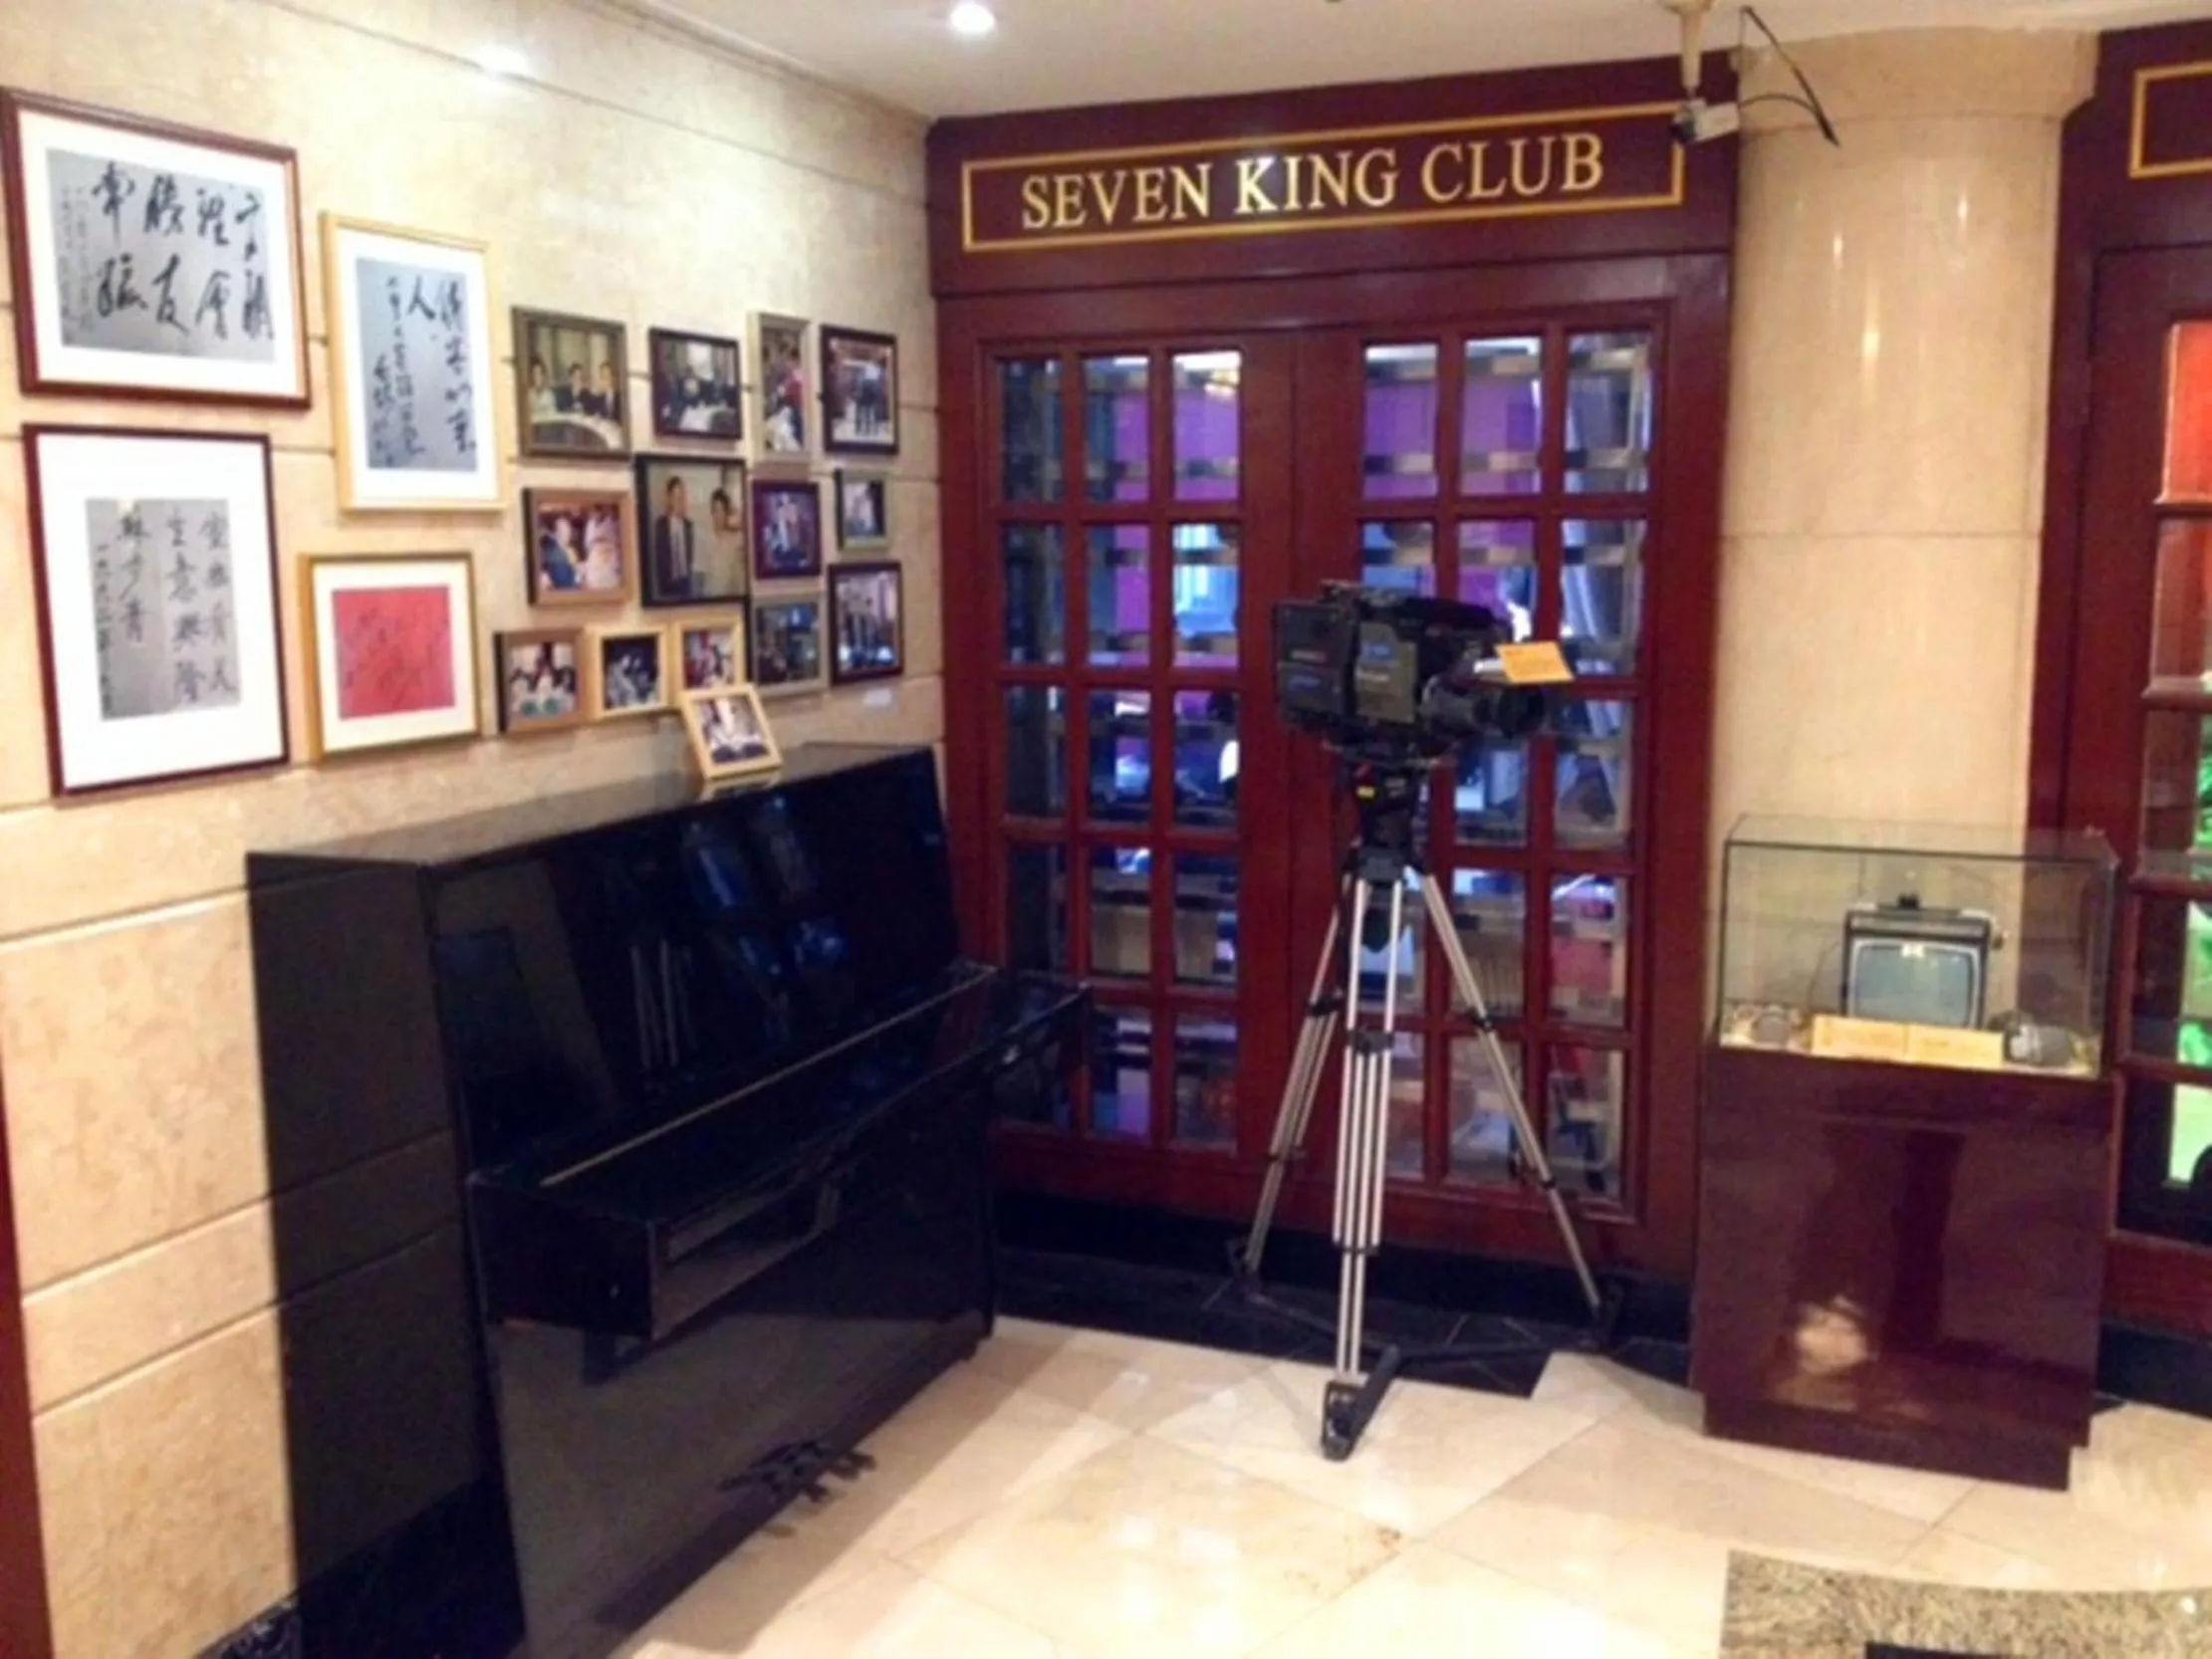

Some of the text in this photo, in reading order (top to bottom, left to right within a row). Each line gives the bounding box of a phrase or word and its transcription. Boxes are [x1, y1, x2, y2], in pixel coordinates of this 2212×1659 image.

[1022, 132, 1604, 229] SEVEN KING CLUB
